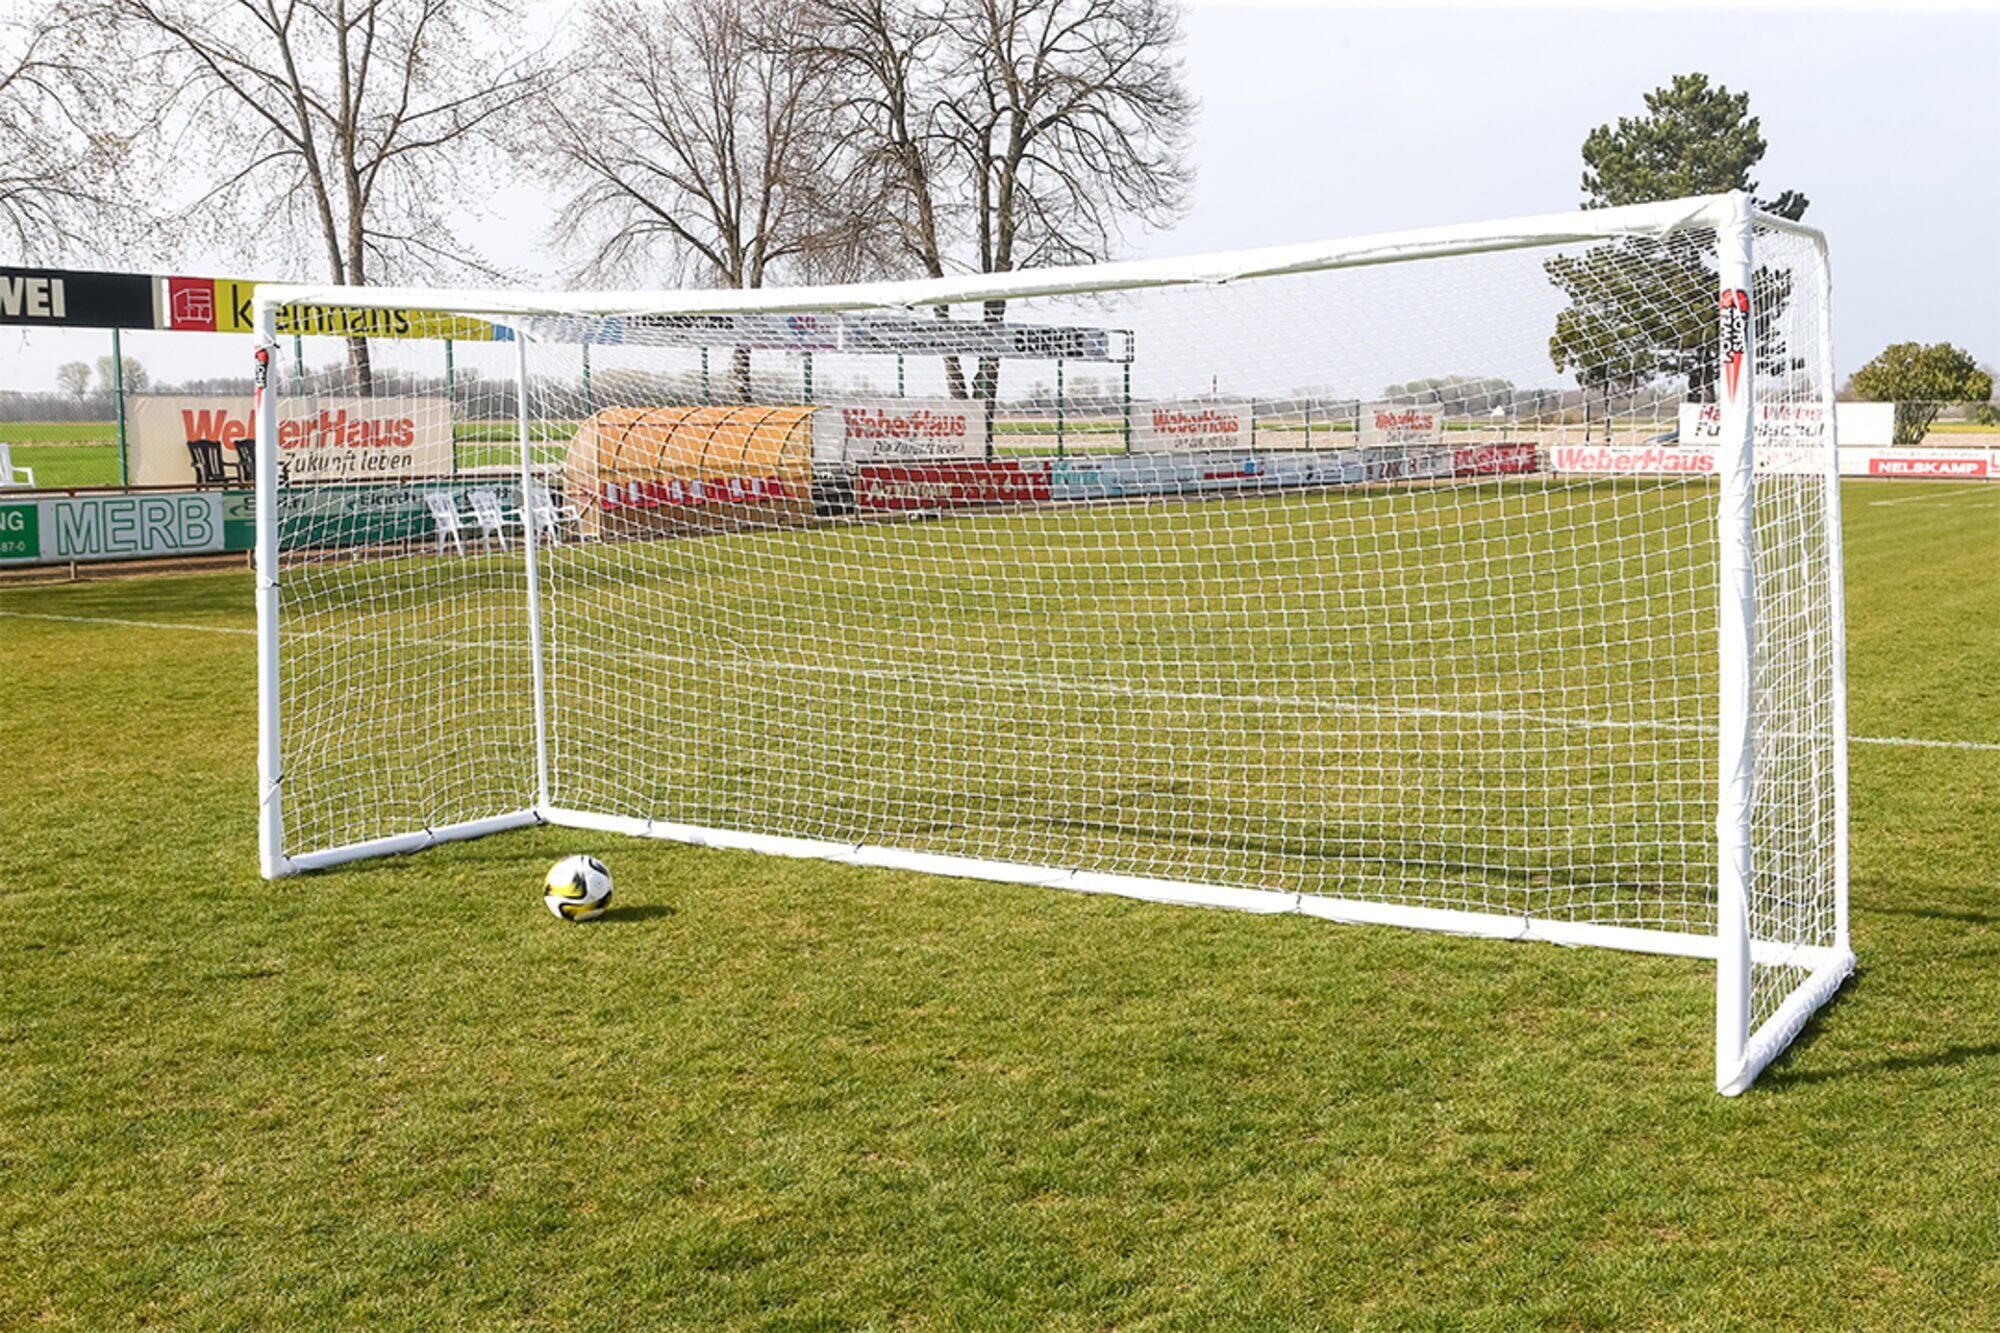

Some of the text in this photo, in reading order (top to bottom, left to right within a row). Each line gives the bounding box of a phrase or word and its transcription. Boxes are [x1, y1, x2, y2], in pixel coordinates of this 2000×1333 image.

[1557, 449, 1715, 471] WeberHaus
[1878, 462, 1979, 473] NELSKAMP
[55, 498, 214, 556] MERB
